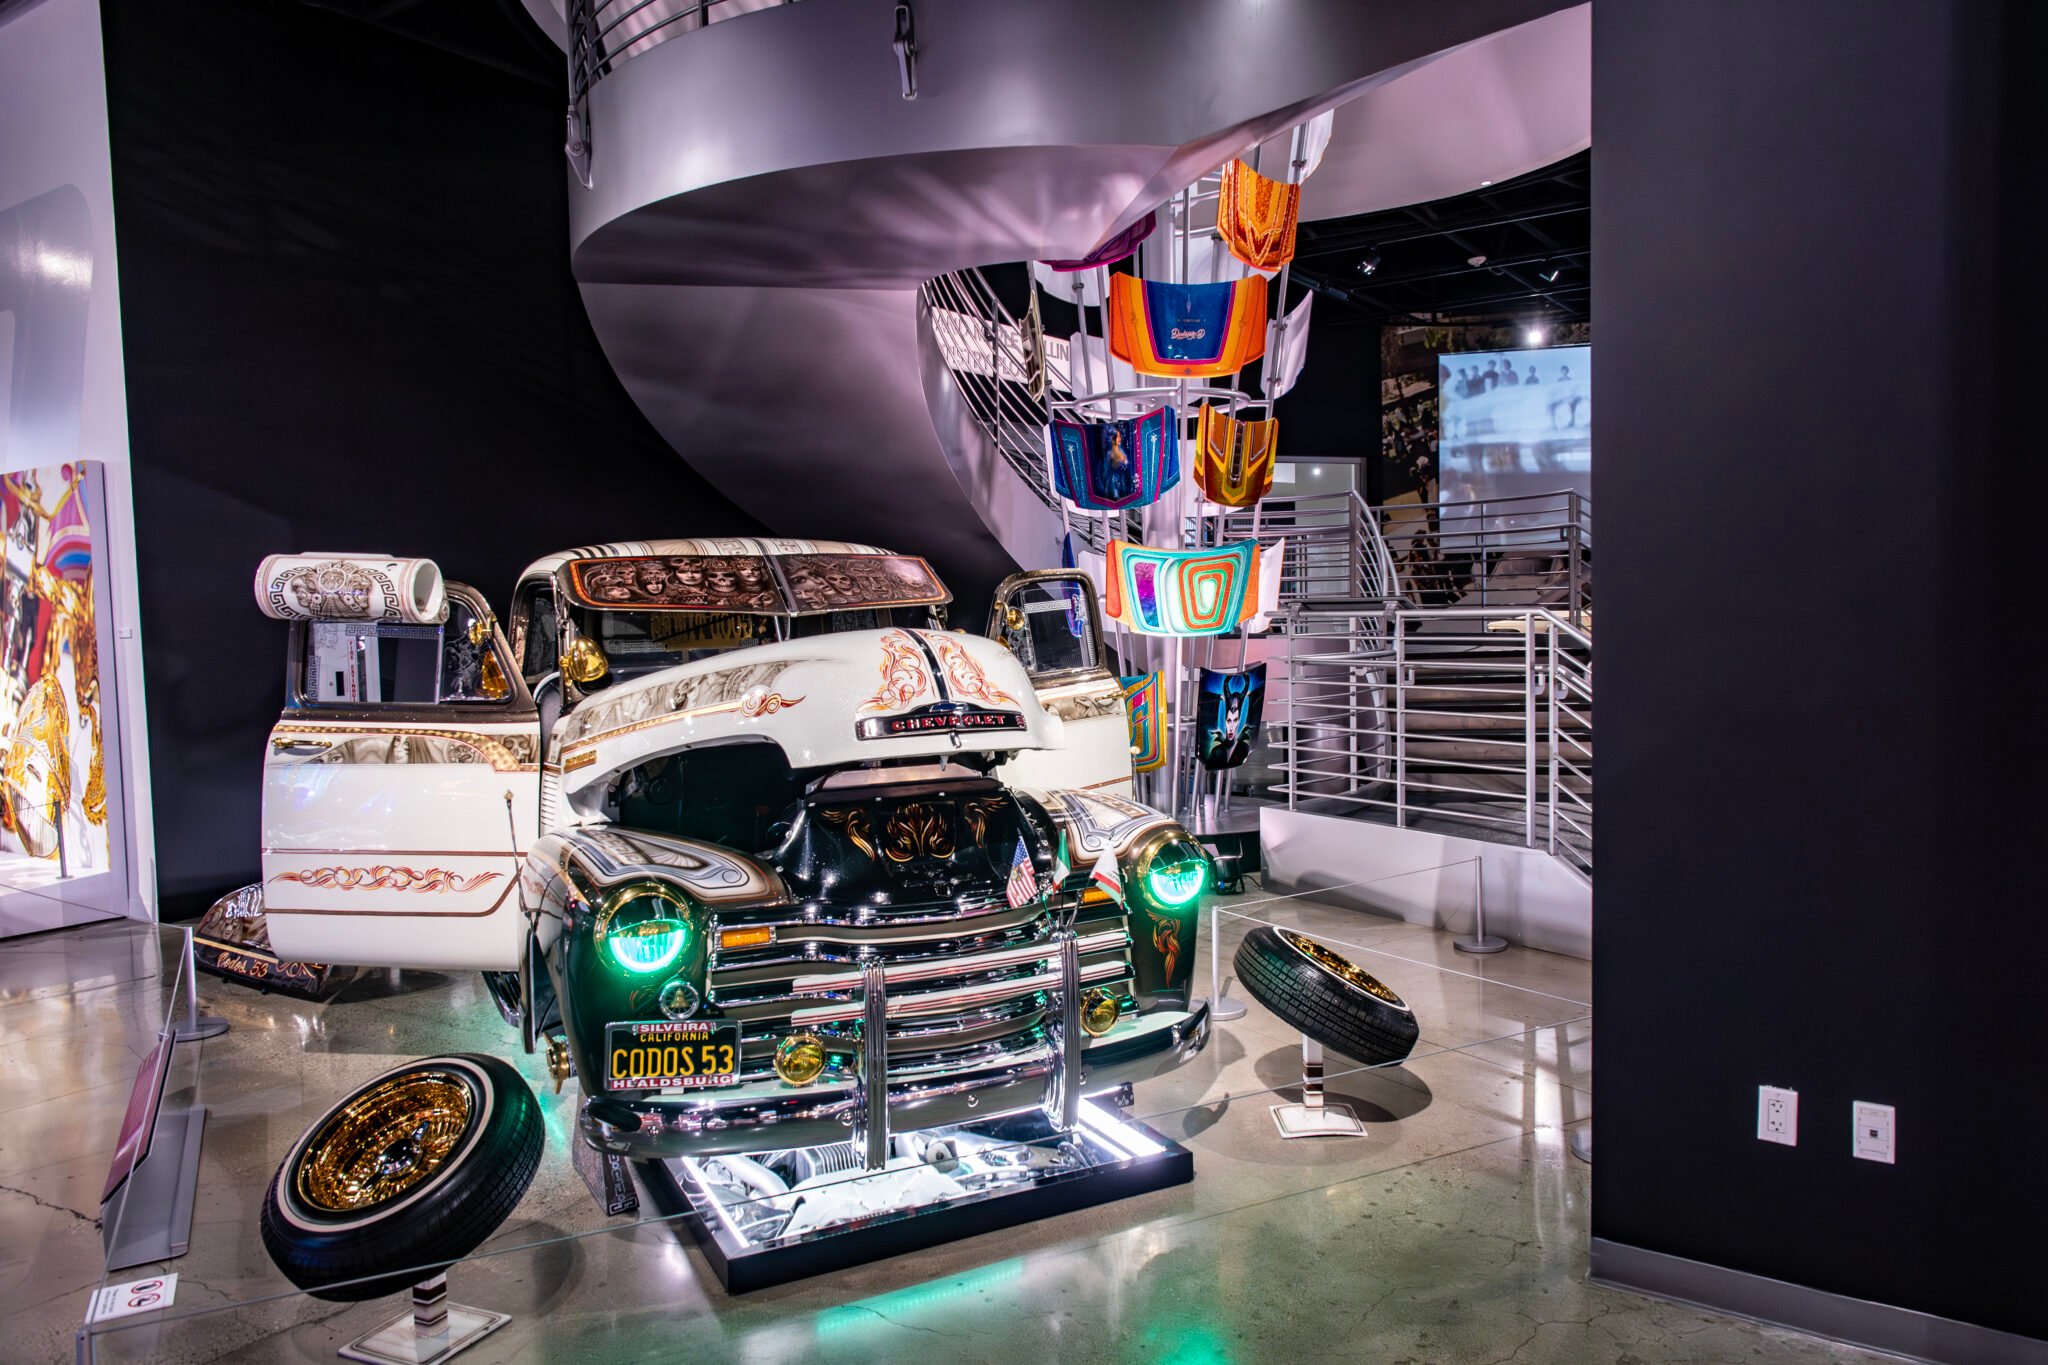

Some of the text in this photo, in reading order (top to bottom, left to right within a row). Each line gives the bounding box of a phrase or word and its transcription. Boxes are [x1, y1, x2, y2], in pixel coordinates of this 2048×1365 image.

[891, 715, 1005, 731] CHEVROLET
[640, 1022, 708, 1033] SILVEIRA
[640, 1032, 709, 1043] CALIFORNIA
[612, 1045, 734, 1078] CODOS 53
[613, 1076, 732, 1089] HEALDSBURG
